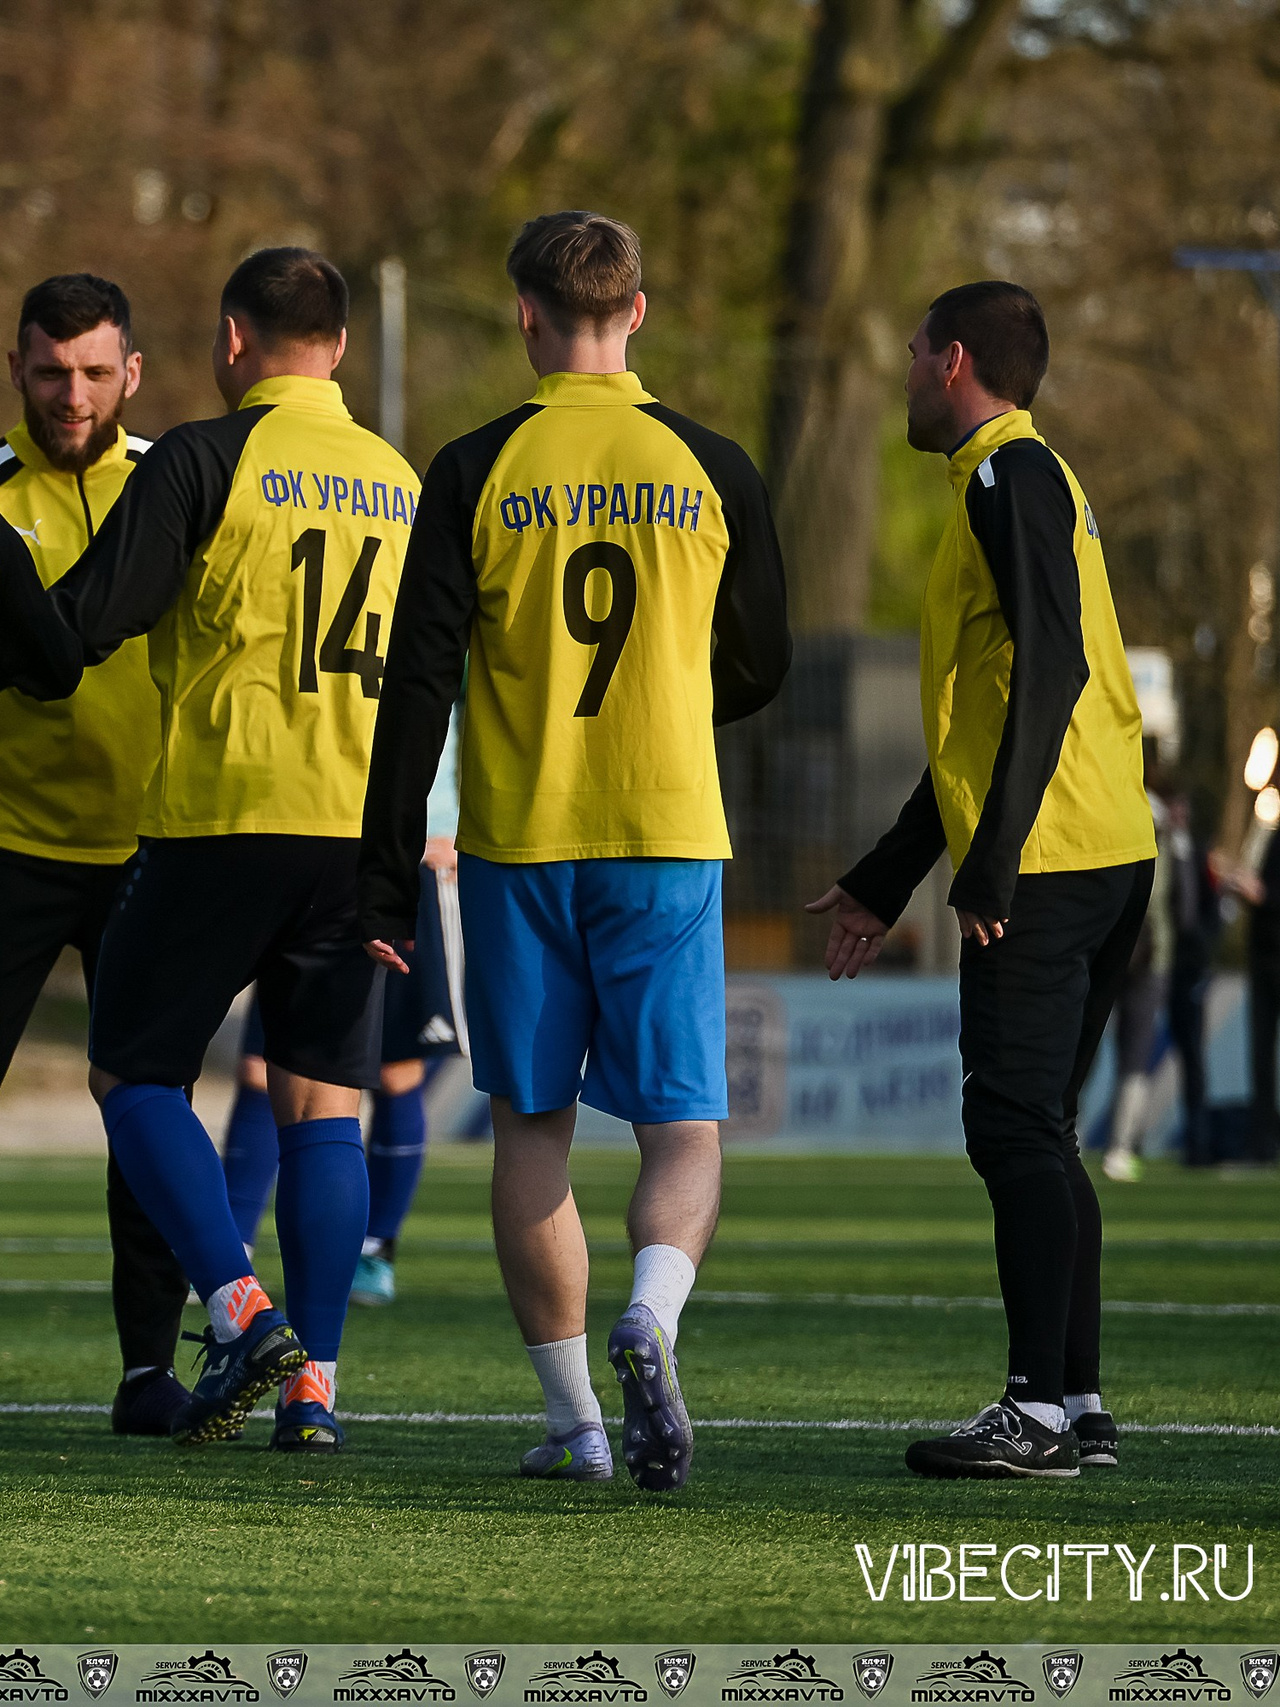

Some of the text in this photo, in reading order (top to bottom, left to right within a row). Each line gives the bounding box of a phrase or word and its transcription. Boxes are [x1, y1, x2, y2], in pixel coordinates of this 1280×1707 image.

[261, 468, 308, 508] ФК
[500, 482, 704, 534] ФК УРАЛАН
[290, 527, 384, 699] 14
[562, 540, 637, 718] 9
[1078, 1440, 1118, 1450] OP-FL
